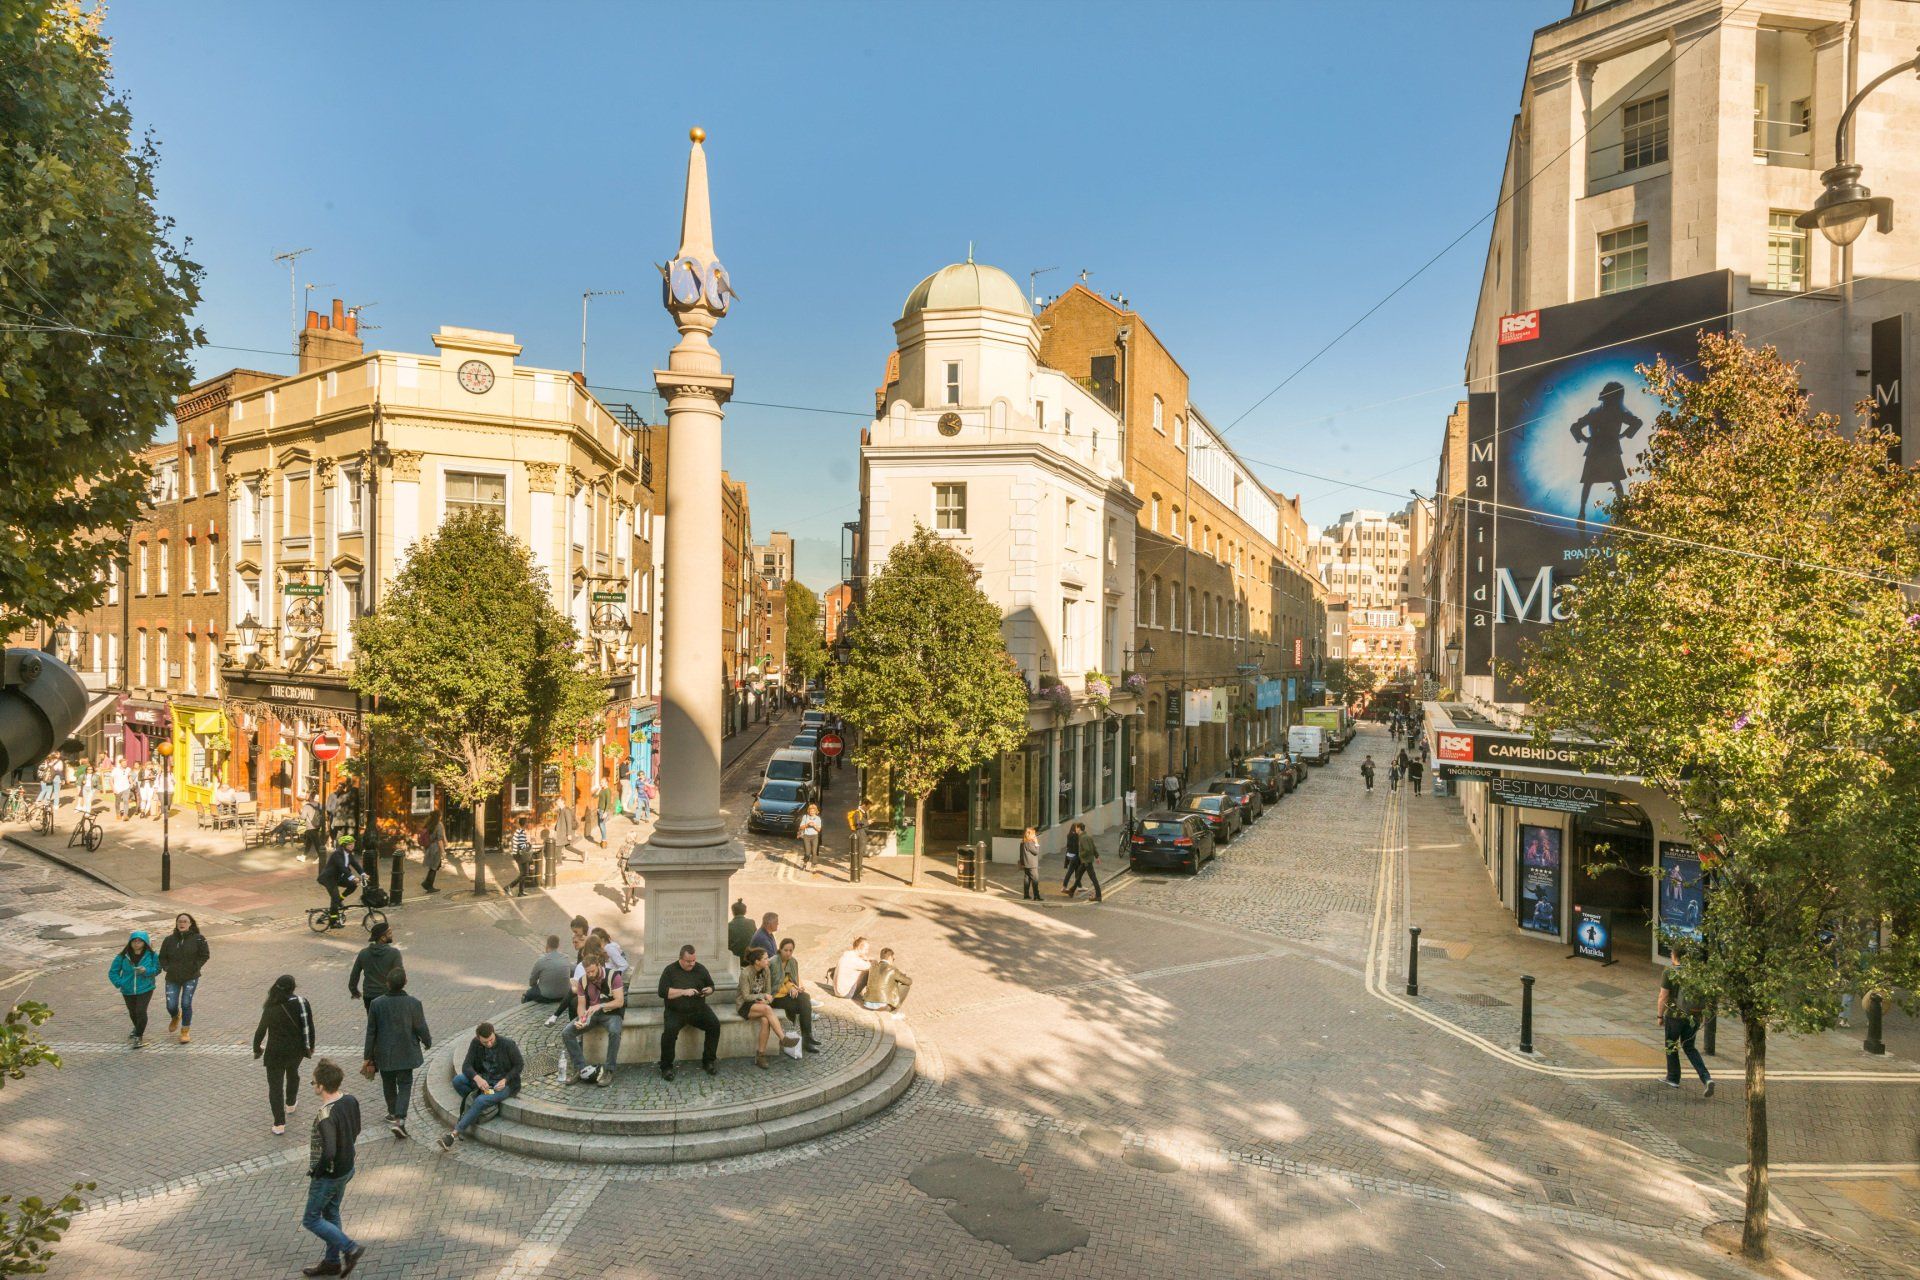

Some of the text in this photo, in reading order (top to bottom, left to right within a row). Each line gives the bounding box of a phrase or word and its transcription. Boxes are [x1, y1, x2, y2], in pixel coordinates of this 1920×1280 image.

[1501, 312, 1537, 333] RSC
[1471, 442, 1493, 627] Matilda
[270, 684, 315, 701] THE CROWN
[1440, 735, 1471, 752] RSC
[1492, 778, 1604, 803] BEST MUSICAL
[1579, 945, 1604, 958] Matilda
